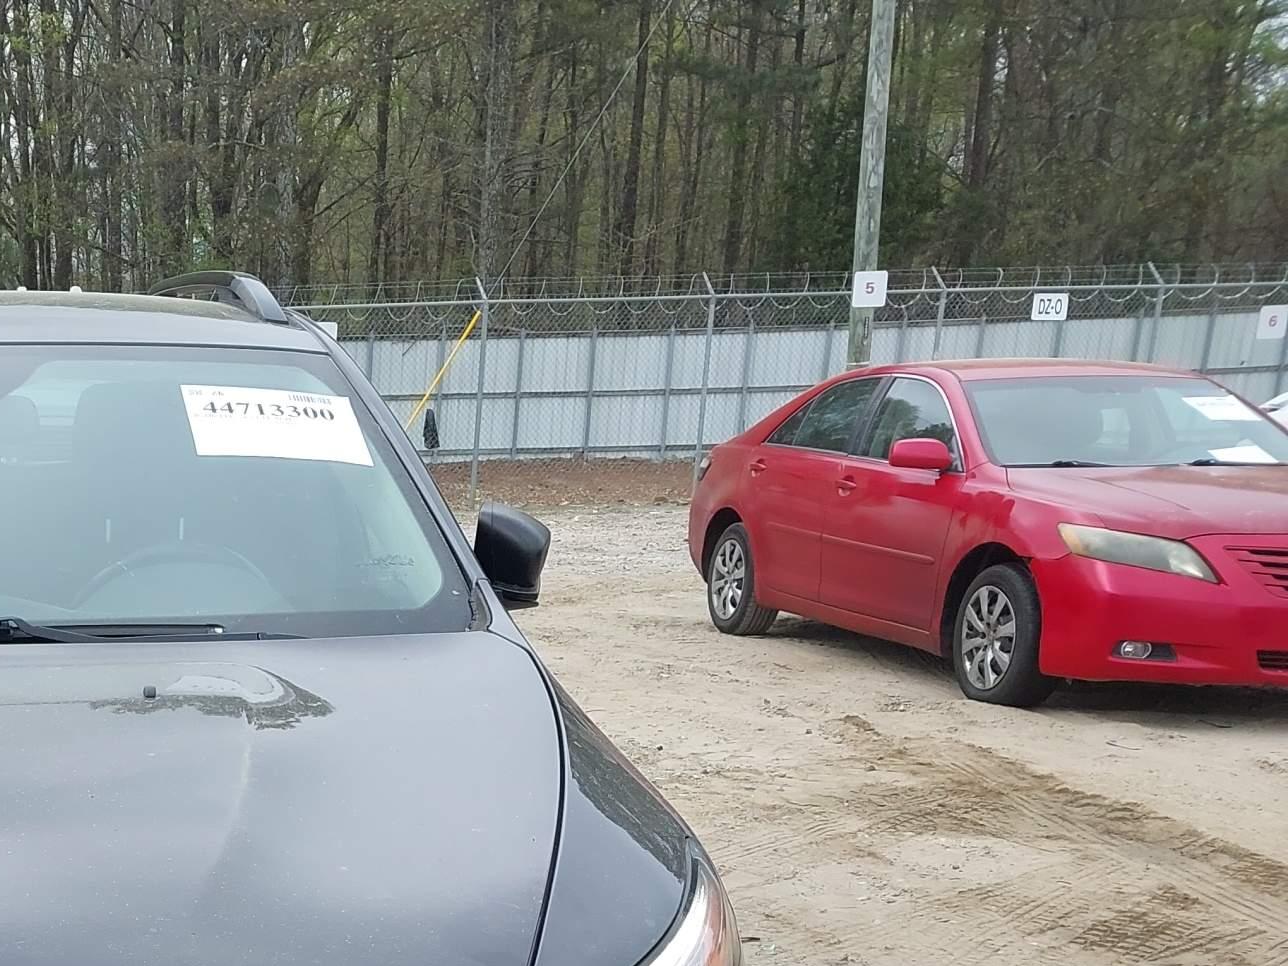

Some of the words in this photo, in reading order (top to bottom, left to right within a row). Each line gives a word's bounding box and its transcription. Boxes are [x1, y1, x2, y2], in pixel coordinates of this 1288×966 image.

[864, 282, 875, 294] 5
[1268, 315, 1278, 327] 6
[202, 401, 335, 421] 44713300
